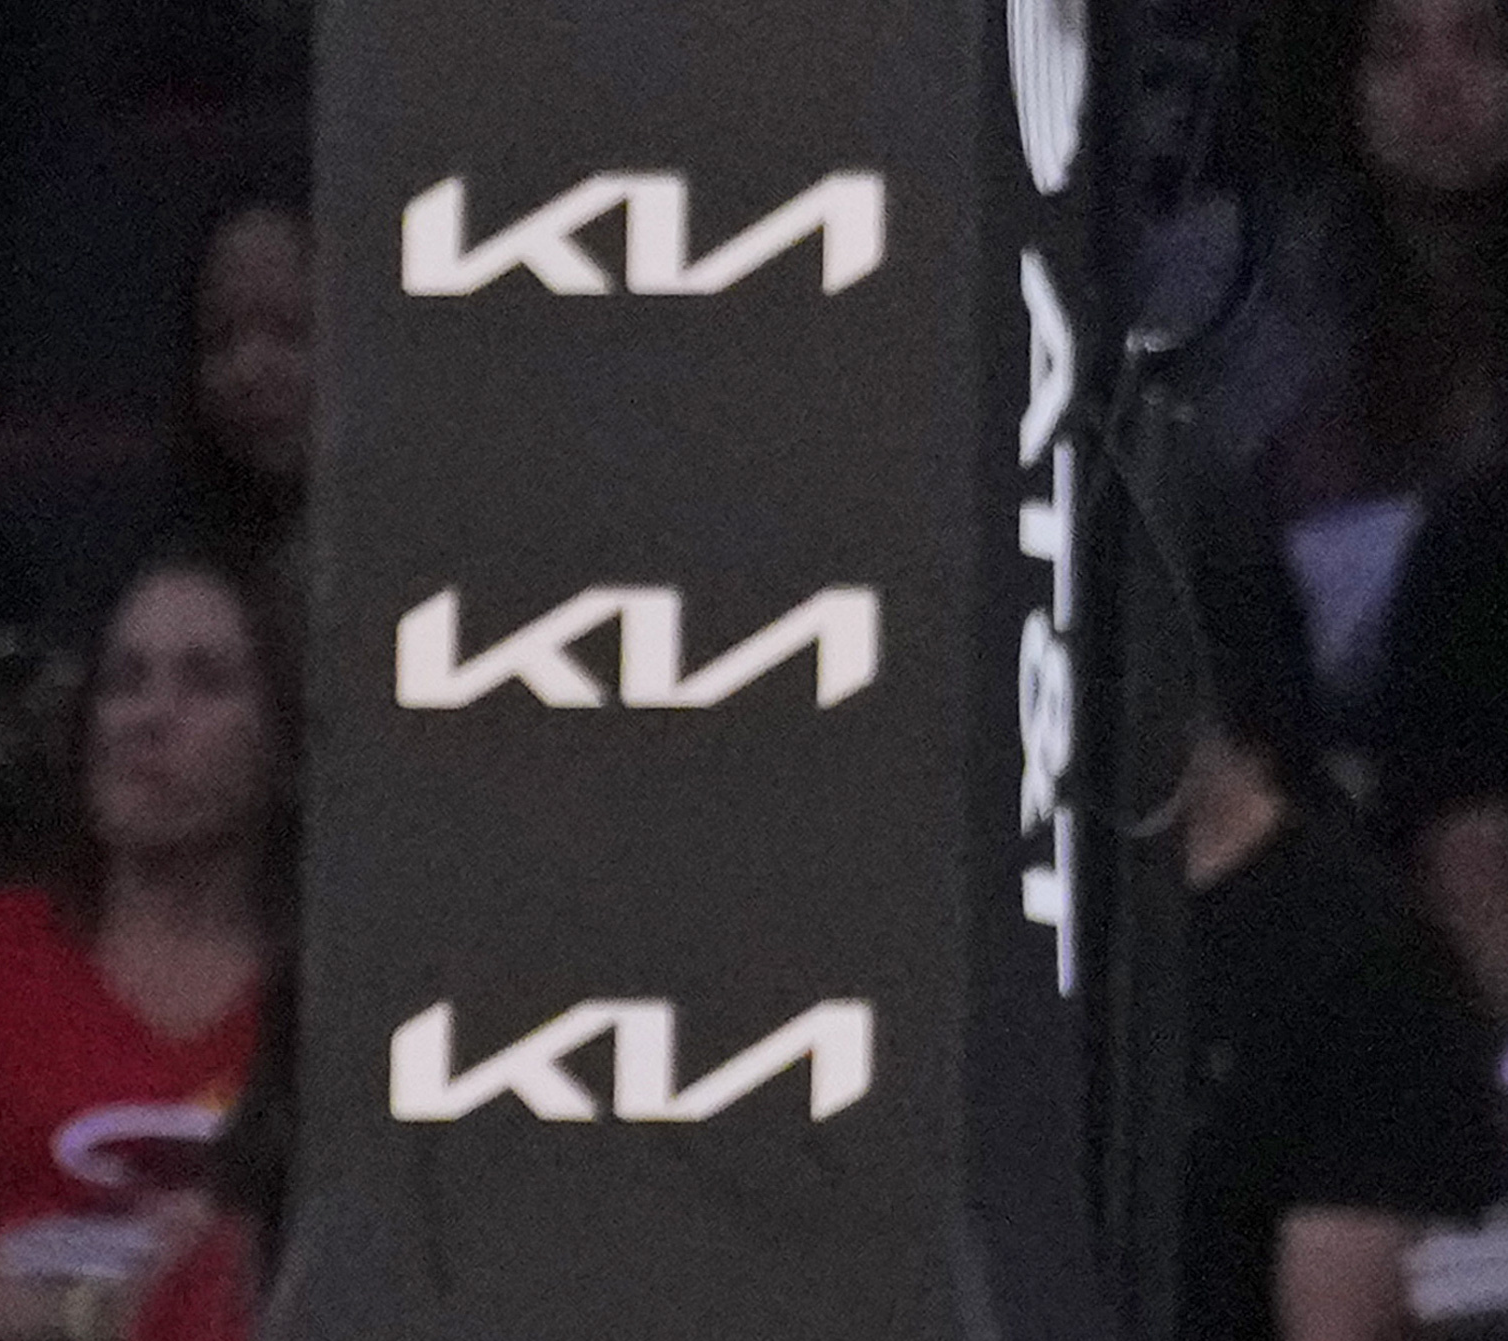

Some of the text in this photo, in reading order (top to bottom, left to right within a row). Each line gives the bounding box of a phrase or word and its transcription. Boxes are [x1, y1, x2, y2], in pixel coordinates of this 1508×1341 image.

[400, 171, 886, 296] KIA
[395, 585, 882, 709] KIA
[1019, 246, 1075, 999] AT&T
[389, 998, 875, 1122] KIA
